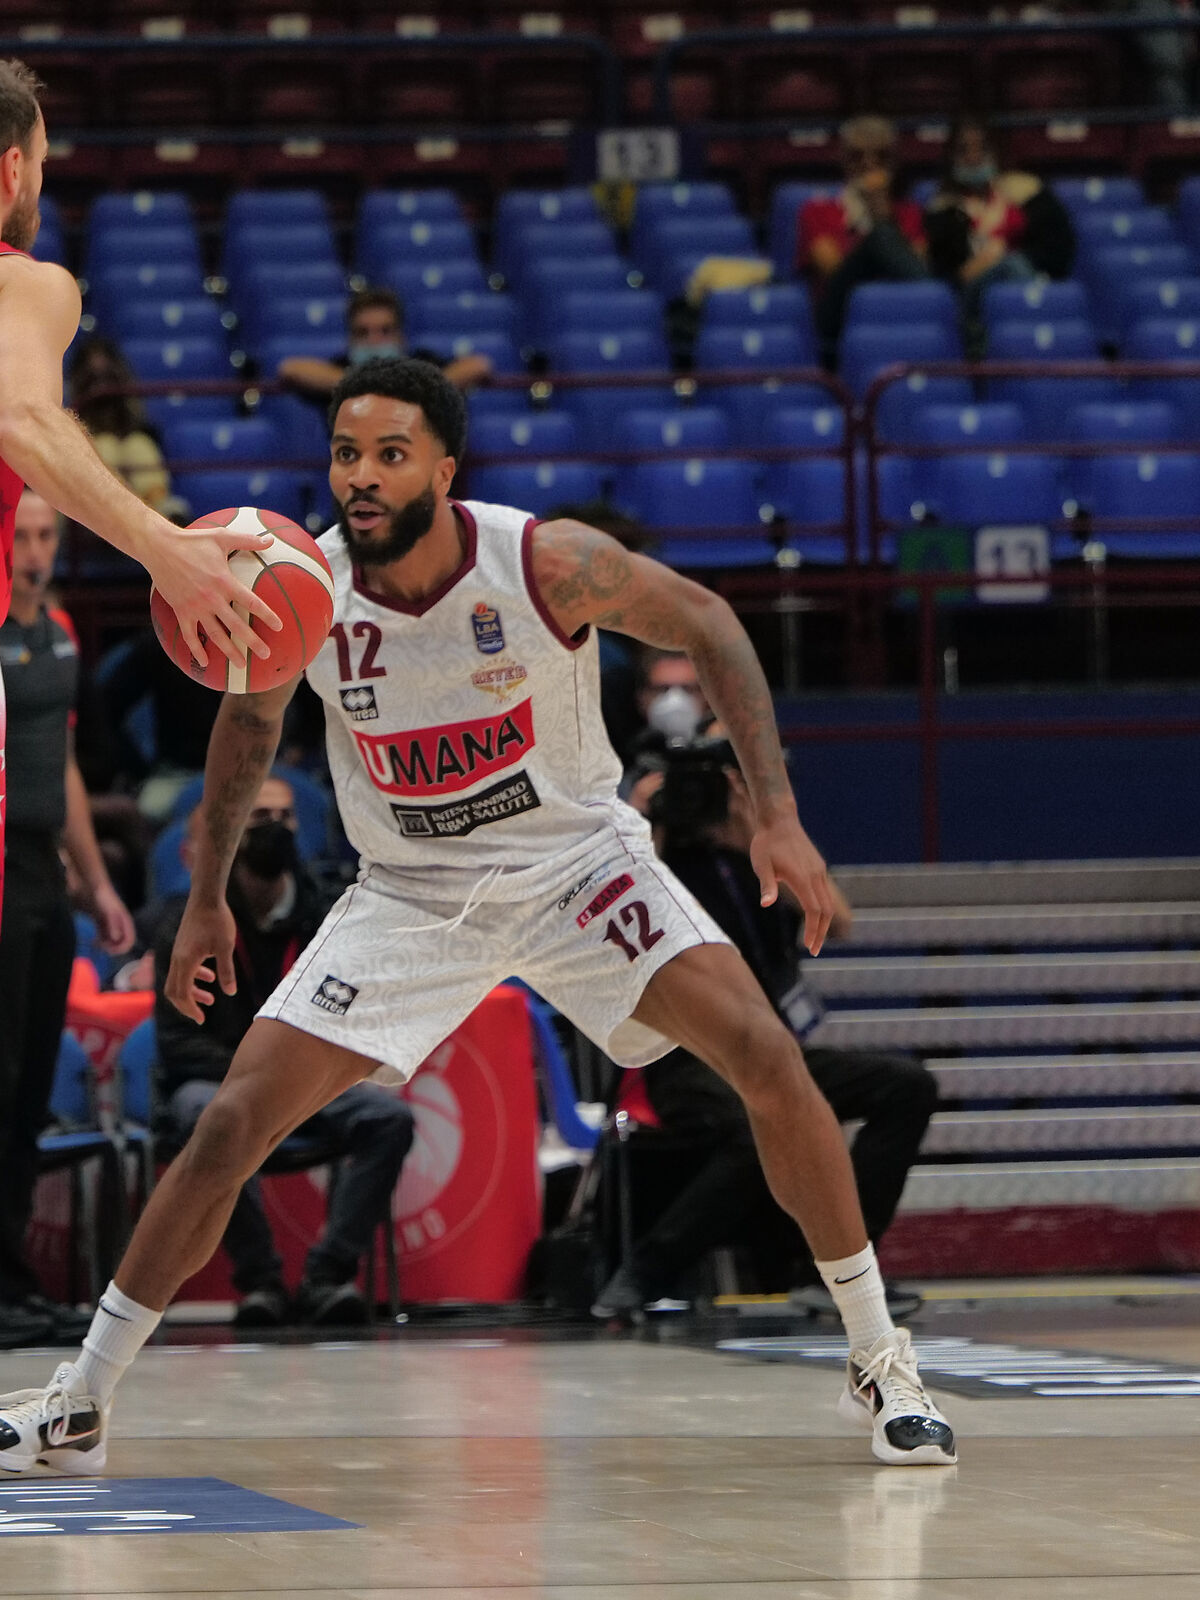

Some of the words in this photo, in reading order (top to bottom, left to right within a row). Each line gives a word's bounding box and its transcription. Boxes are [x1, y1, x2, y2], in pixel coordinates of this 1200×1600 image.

[328, 621, 387, 682] 12
[361, 715, 525, 787] UMANA
[435, 815, 471, 834] RBM
[472, 792, 533, 821] SALUTE
[580, 875, 629, 924] UMANA
[602, 901, 666, 963] 12
